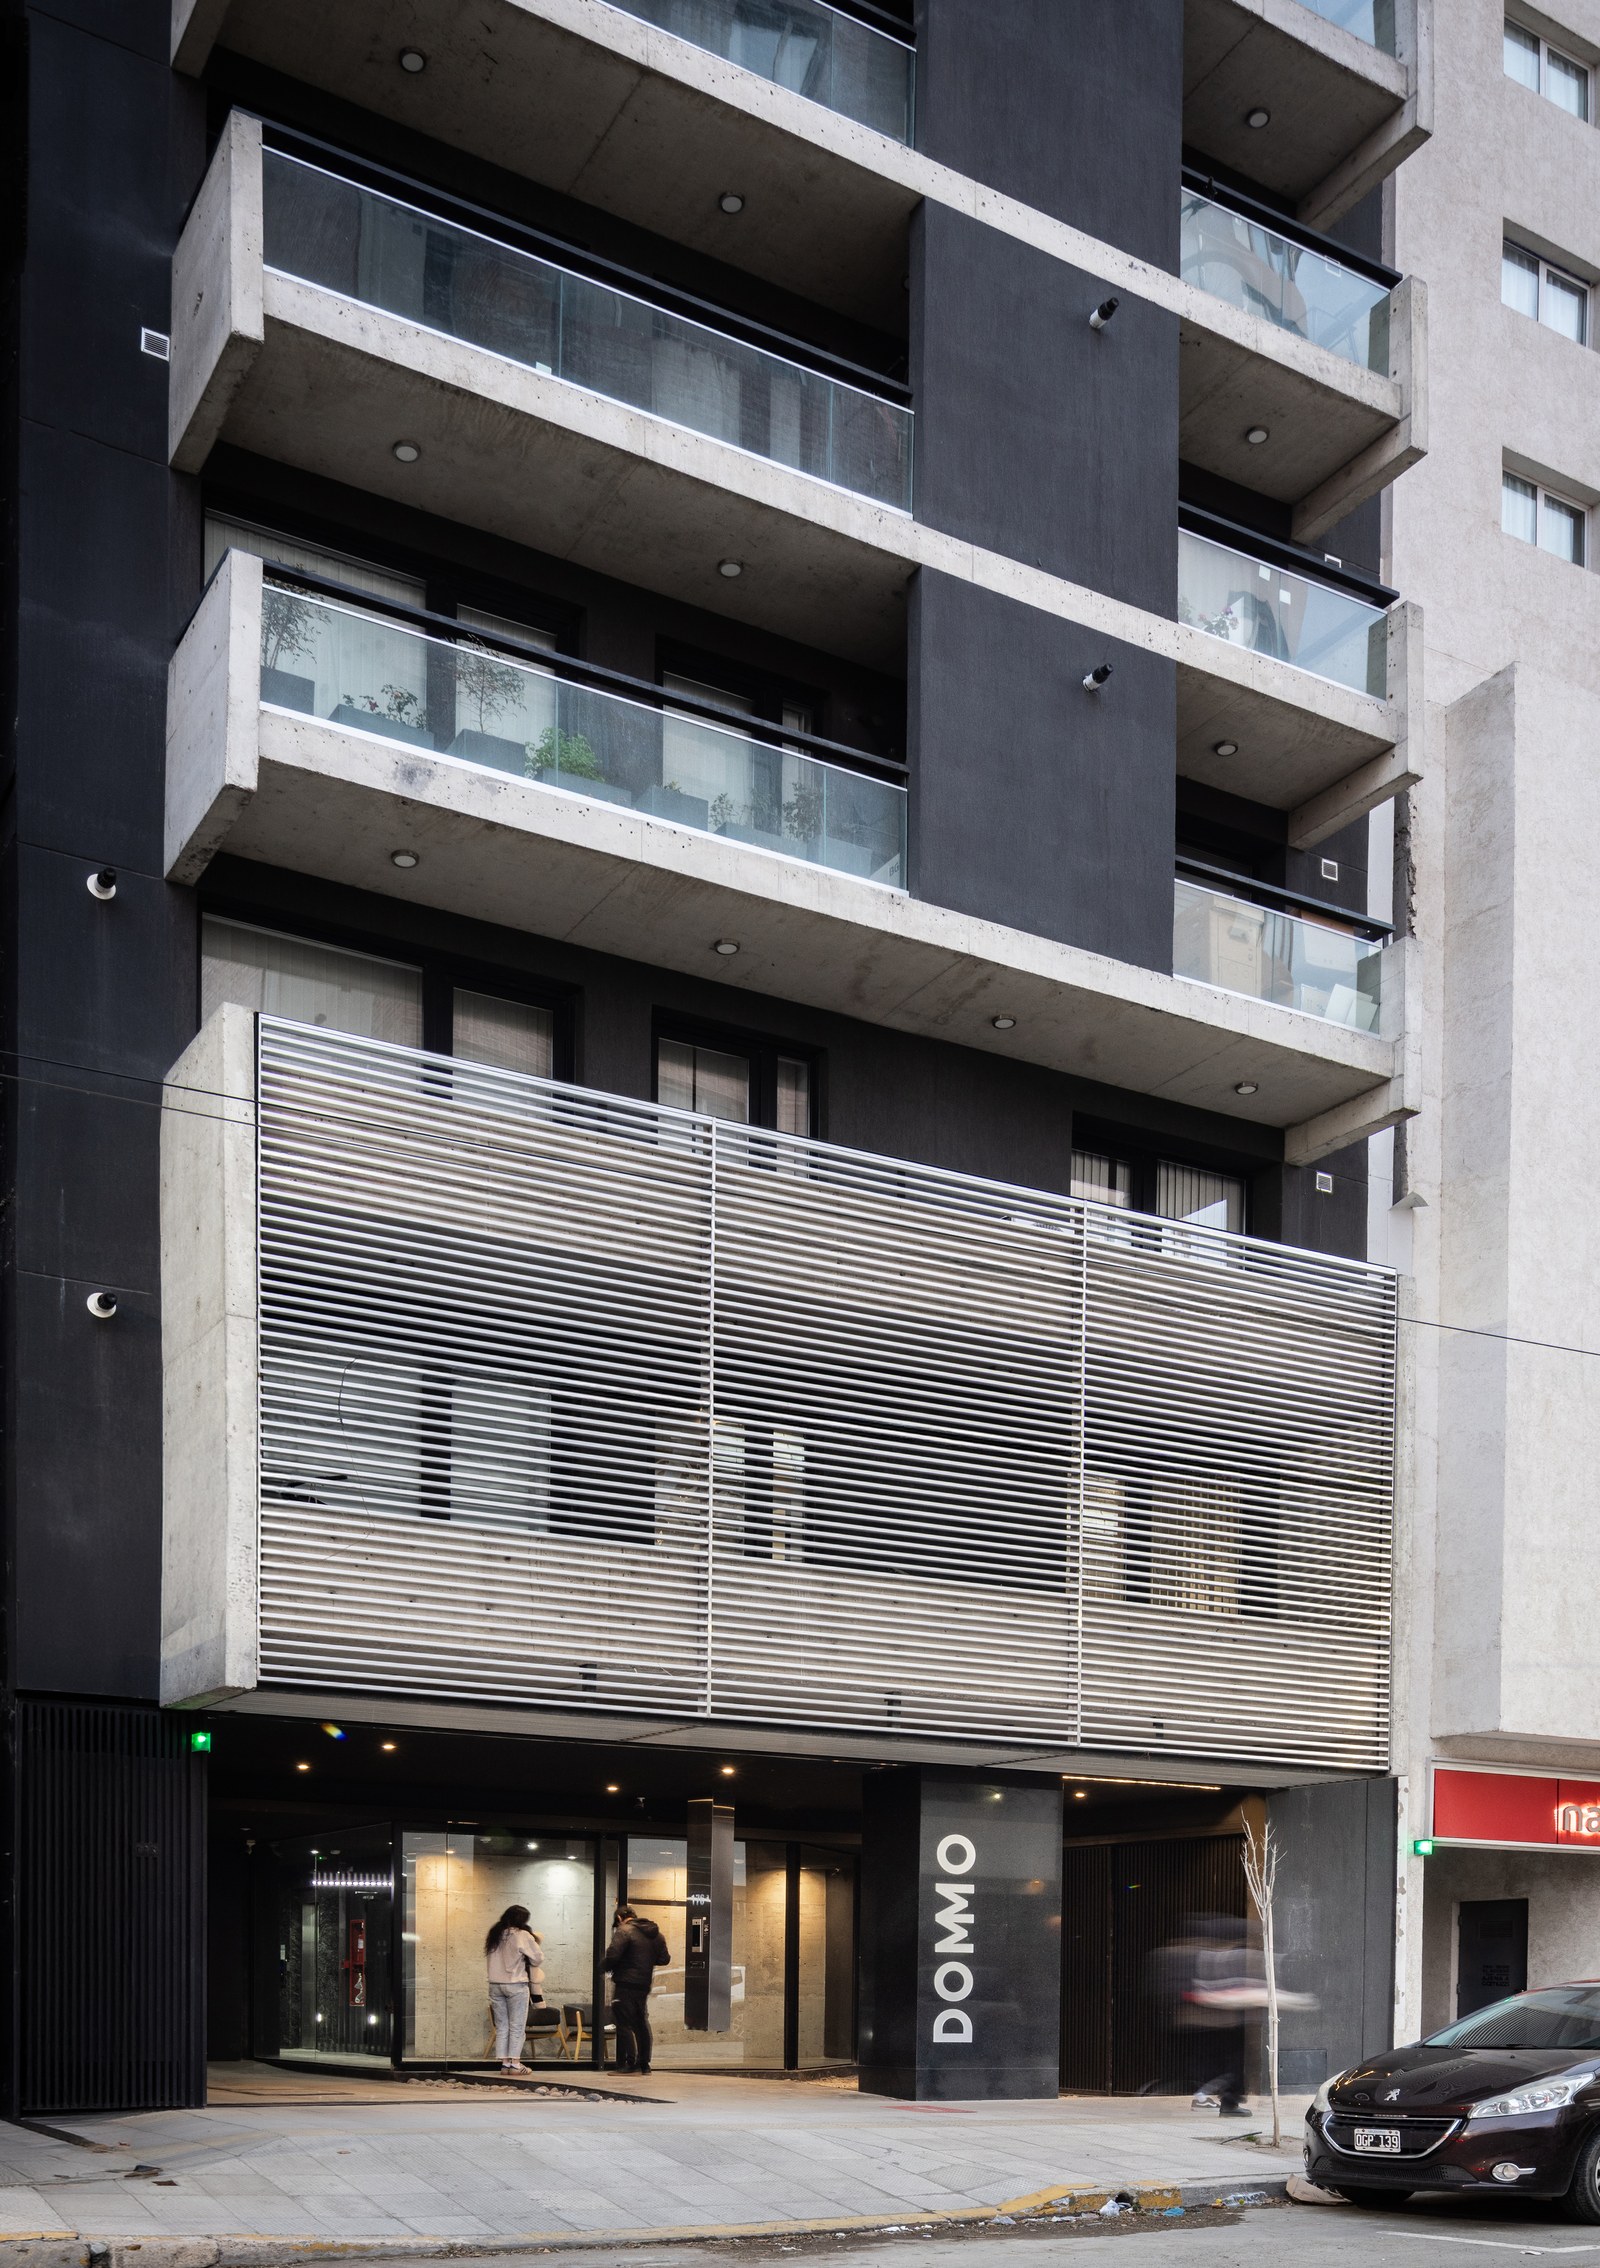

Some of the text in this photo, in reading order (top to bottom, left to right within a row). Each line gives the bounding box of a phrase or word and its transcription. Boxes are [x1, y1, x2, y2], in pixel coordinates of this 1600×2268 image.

[1562, 1805, 1600, 1833] na
[933, 1834, 976, 2043] DOMO
[1356, 2134, 1398, 2148] OGP 139
